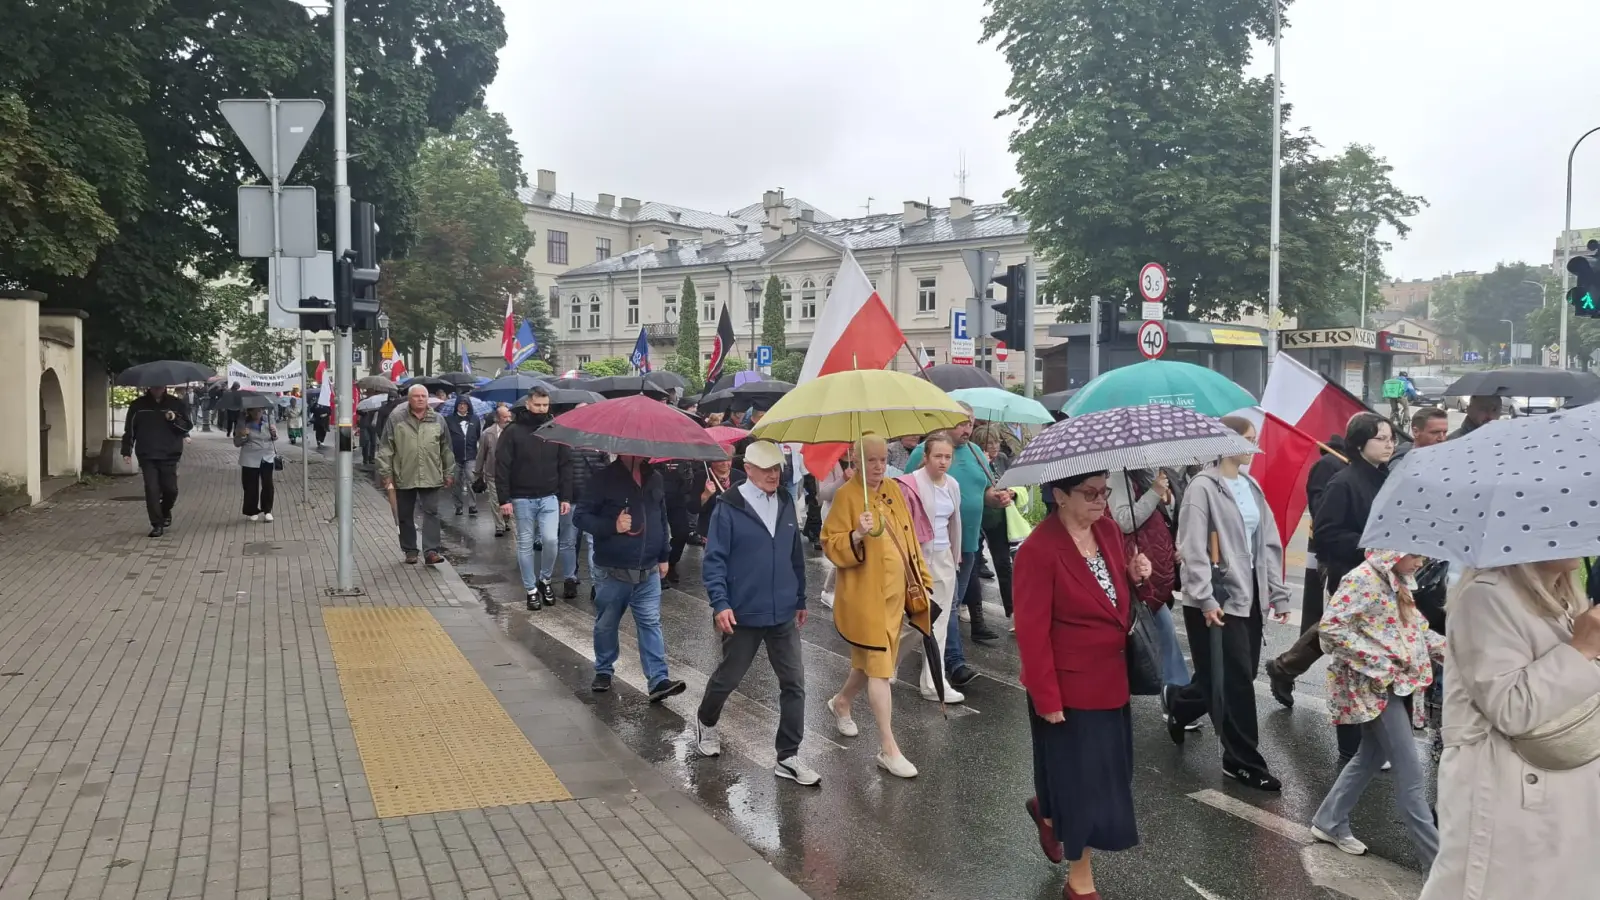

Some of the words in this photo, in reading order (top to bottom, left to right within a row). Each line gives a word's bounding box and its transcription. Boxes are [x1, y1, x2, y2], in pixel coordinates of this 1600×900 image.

[1143, 331, 1162, 349] 40
[1285, 330, 1351, 346] KSERO
[1355, 330, 1376, 346] KSERO
[760, 348, 769, 364] P
[1149, 396, 1195, 406] Palmlive
